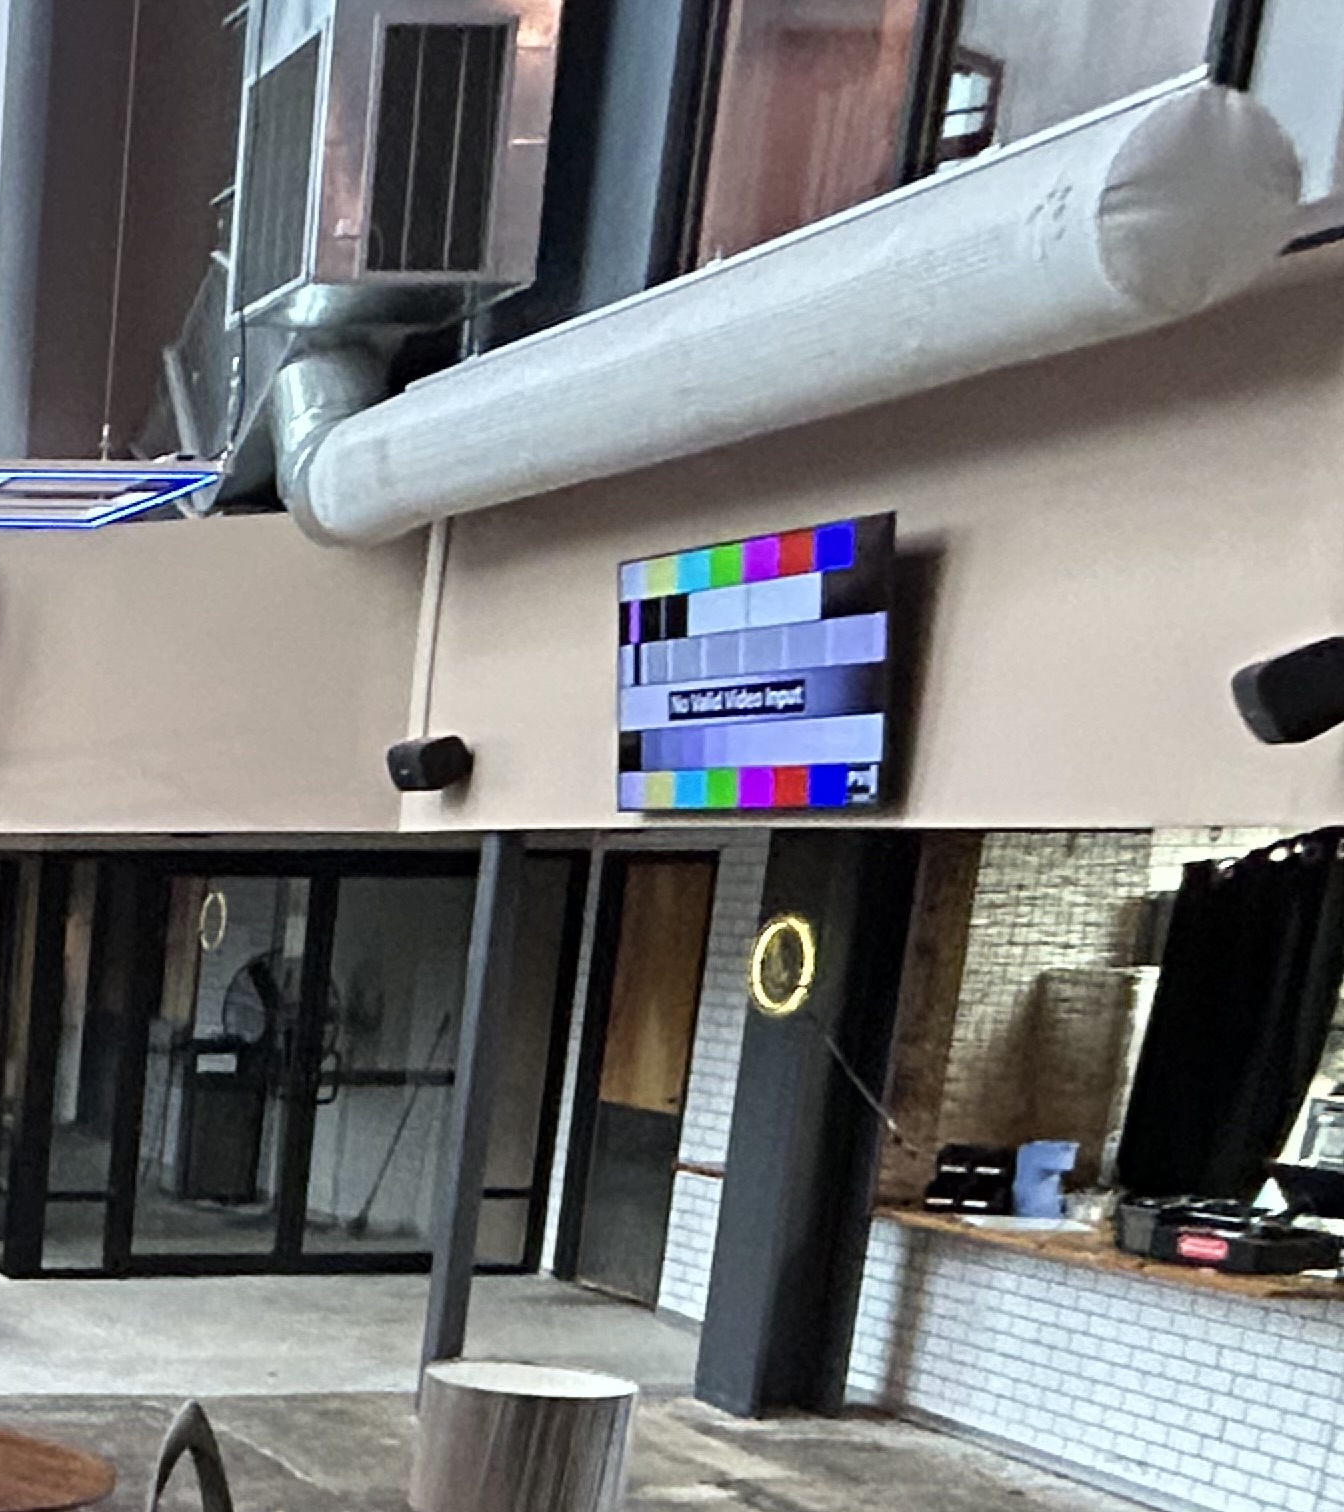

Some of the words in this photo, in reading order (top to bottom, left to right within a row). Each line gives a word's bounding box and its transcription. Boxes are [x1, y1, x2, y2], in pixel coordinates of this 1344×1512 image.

[672, 694, 689, 713] No
[691, 690, 722, 712] Valid
[725, 688, 762, 709] Video
[765, 686, 802, 709] Input
